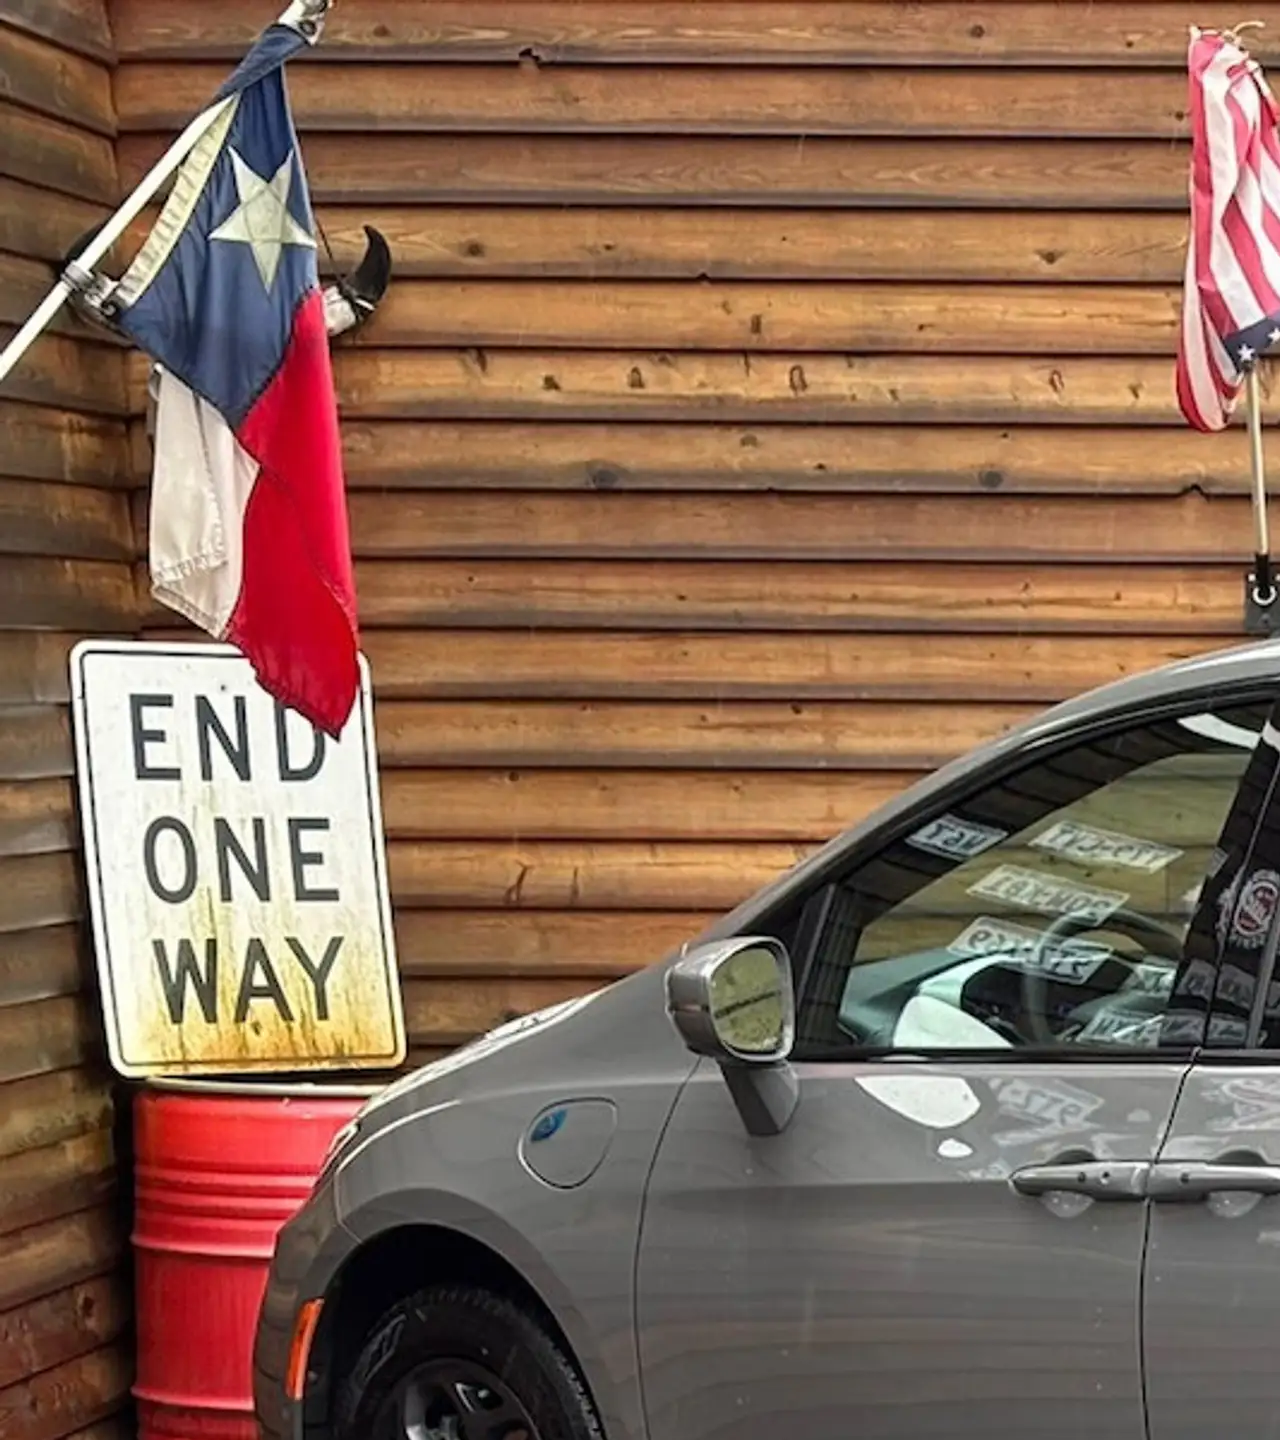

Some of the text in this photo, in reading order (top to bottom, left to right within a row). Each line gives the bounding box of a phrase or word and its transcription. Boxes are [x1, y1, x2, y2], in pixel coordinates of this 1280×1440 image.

[129, 693, 329, 782] END
[142, 815, 341, 904] ONE
[151, 935, 345, 1025] WAY
